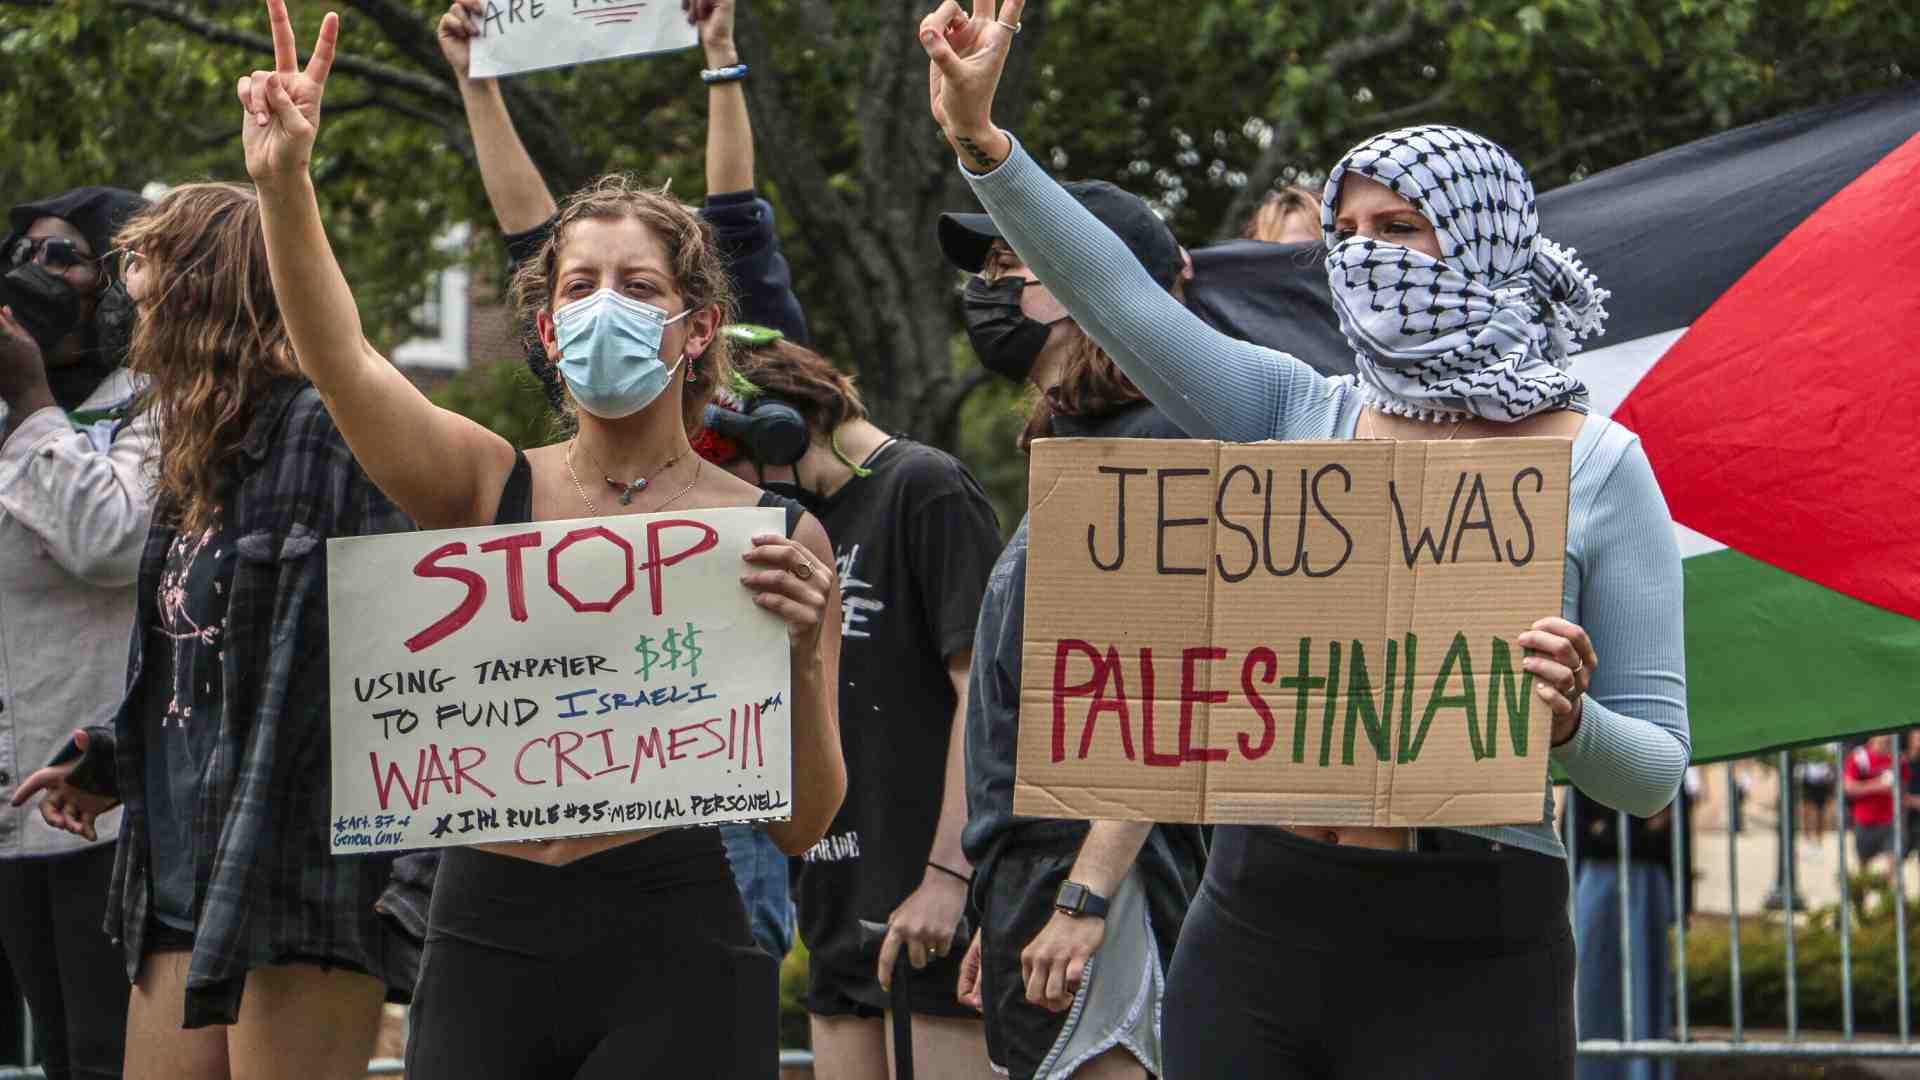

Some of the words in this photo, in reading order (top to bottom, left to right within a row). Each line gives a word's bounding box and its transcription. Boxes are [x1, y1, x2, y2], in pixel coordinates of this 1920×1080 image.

[483, 0, 544, 38] ARE
[1088, 463, 1353, 584] JESUS
[1389, 467, 1543, 570] WAS
[404, 519, 719, 653] STOP
[354, 668, 457, 702] USING
[474, 655, 618, 685] TAXPAYER
[1051, 632, 1534, 767] PALESTINIAN
[372, 707, 419, 740] TO
[436, 697, 539, 729] FUND
[556, 683, 717, 718] ISRAELI
[370, 743, 496, 811] WAR
[506, 804, 560, 828] RULE
[690, 790, 788, 816] PERSONELL
